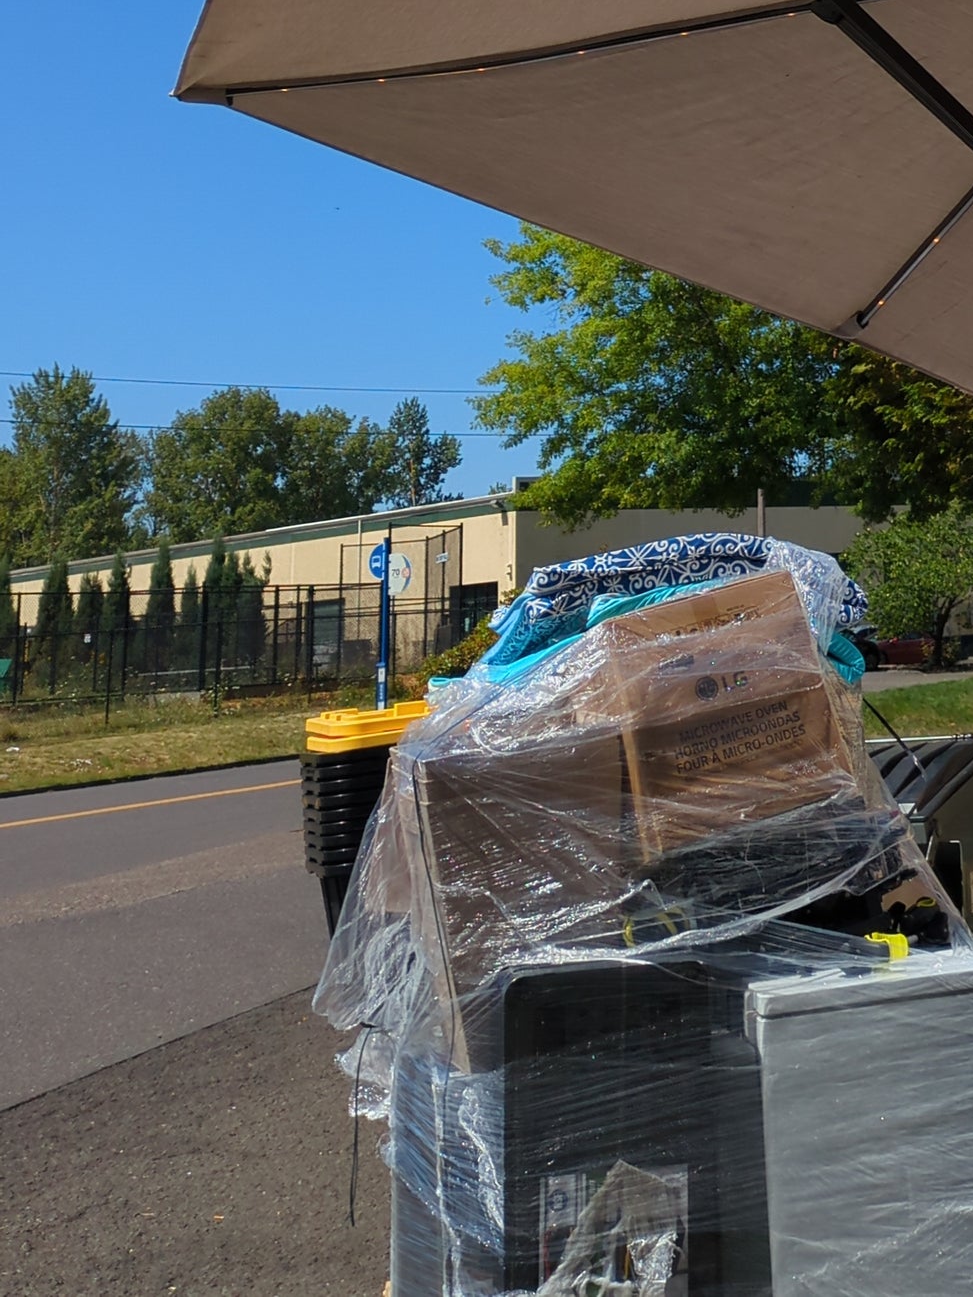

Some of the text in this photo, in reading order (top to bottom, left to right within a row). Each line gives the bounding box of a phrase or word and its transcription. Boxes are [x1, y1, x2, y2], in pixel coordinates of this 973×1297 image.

[391, 568, 400, 577] 70
[722, 670, 748, 692] LG
[675, 710, 801, 760] HORNO MICROONDAS
[679, 701, 788, 743] MICROWAVE OVEN
[676, 755, 709, 774] FOUR
[722, 724, 806, 759] MICRO-ONDES
